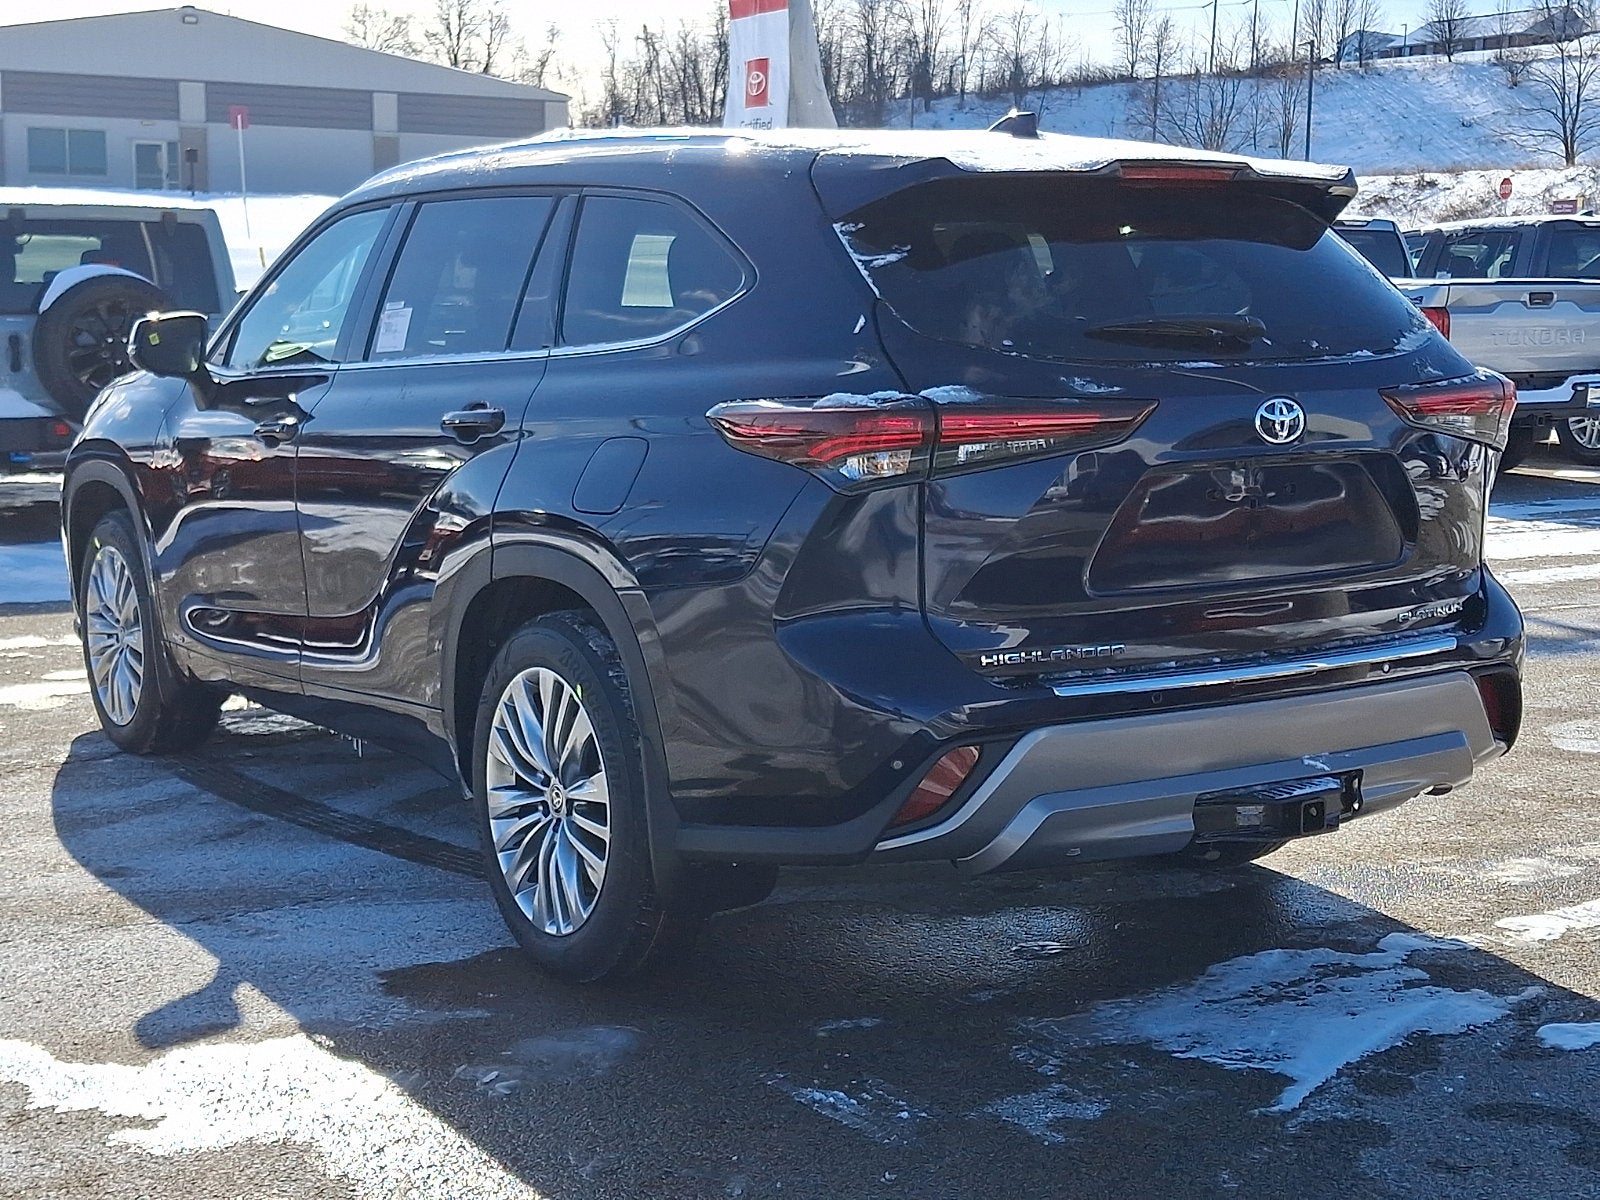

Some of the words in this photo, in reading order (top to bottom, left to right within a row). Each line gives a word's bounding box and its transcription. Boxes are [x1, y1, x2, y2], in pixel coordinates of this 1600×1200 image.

[1490, 327, 1585, 346] TUNDRA
[1398, 602, 1463, 623] PLATINUM
[980, 644, 1126, 666] HIGHLANDER
